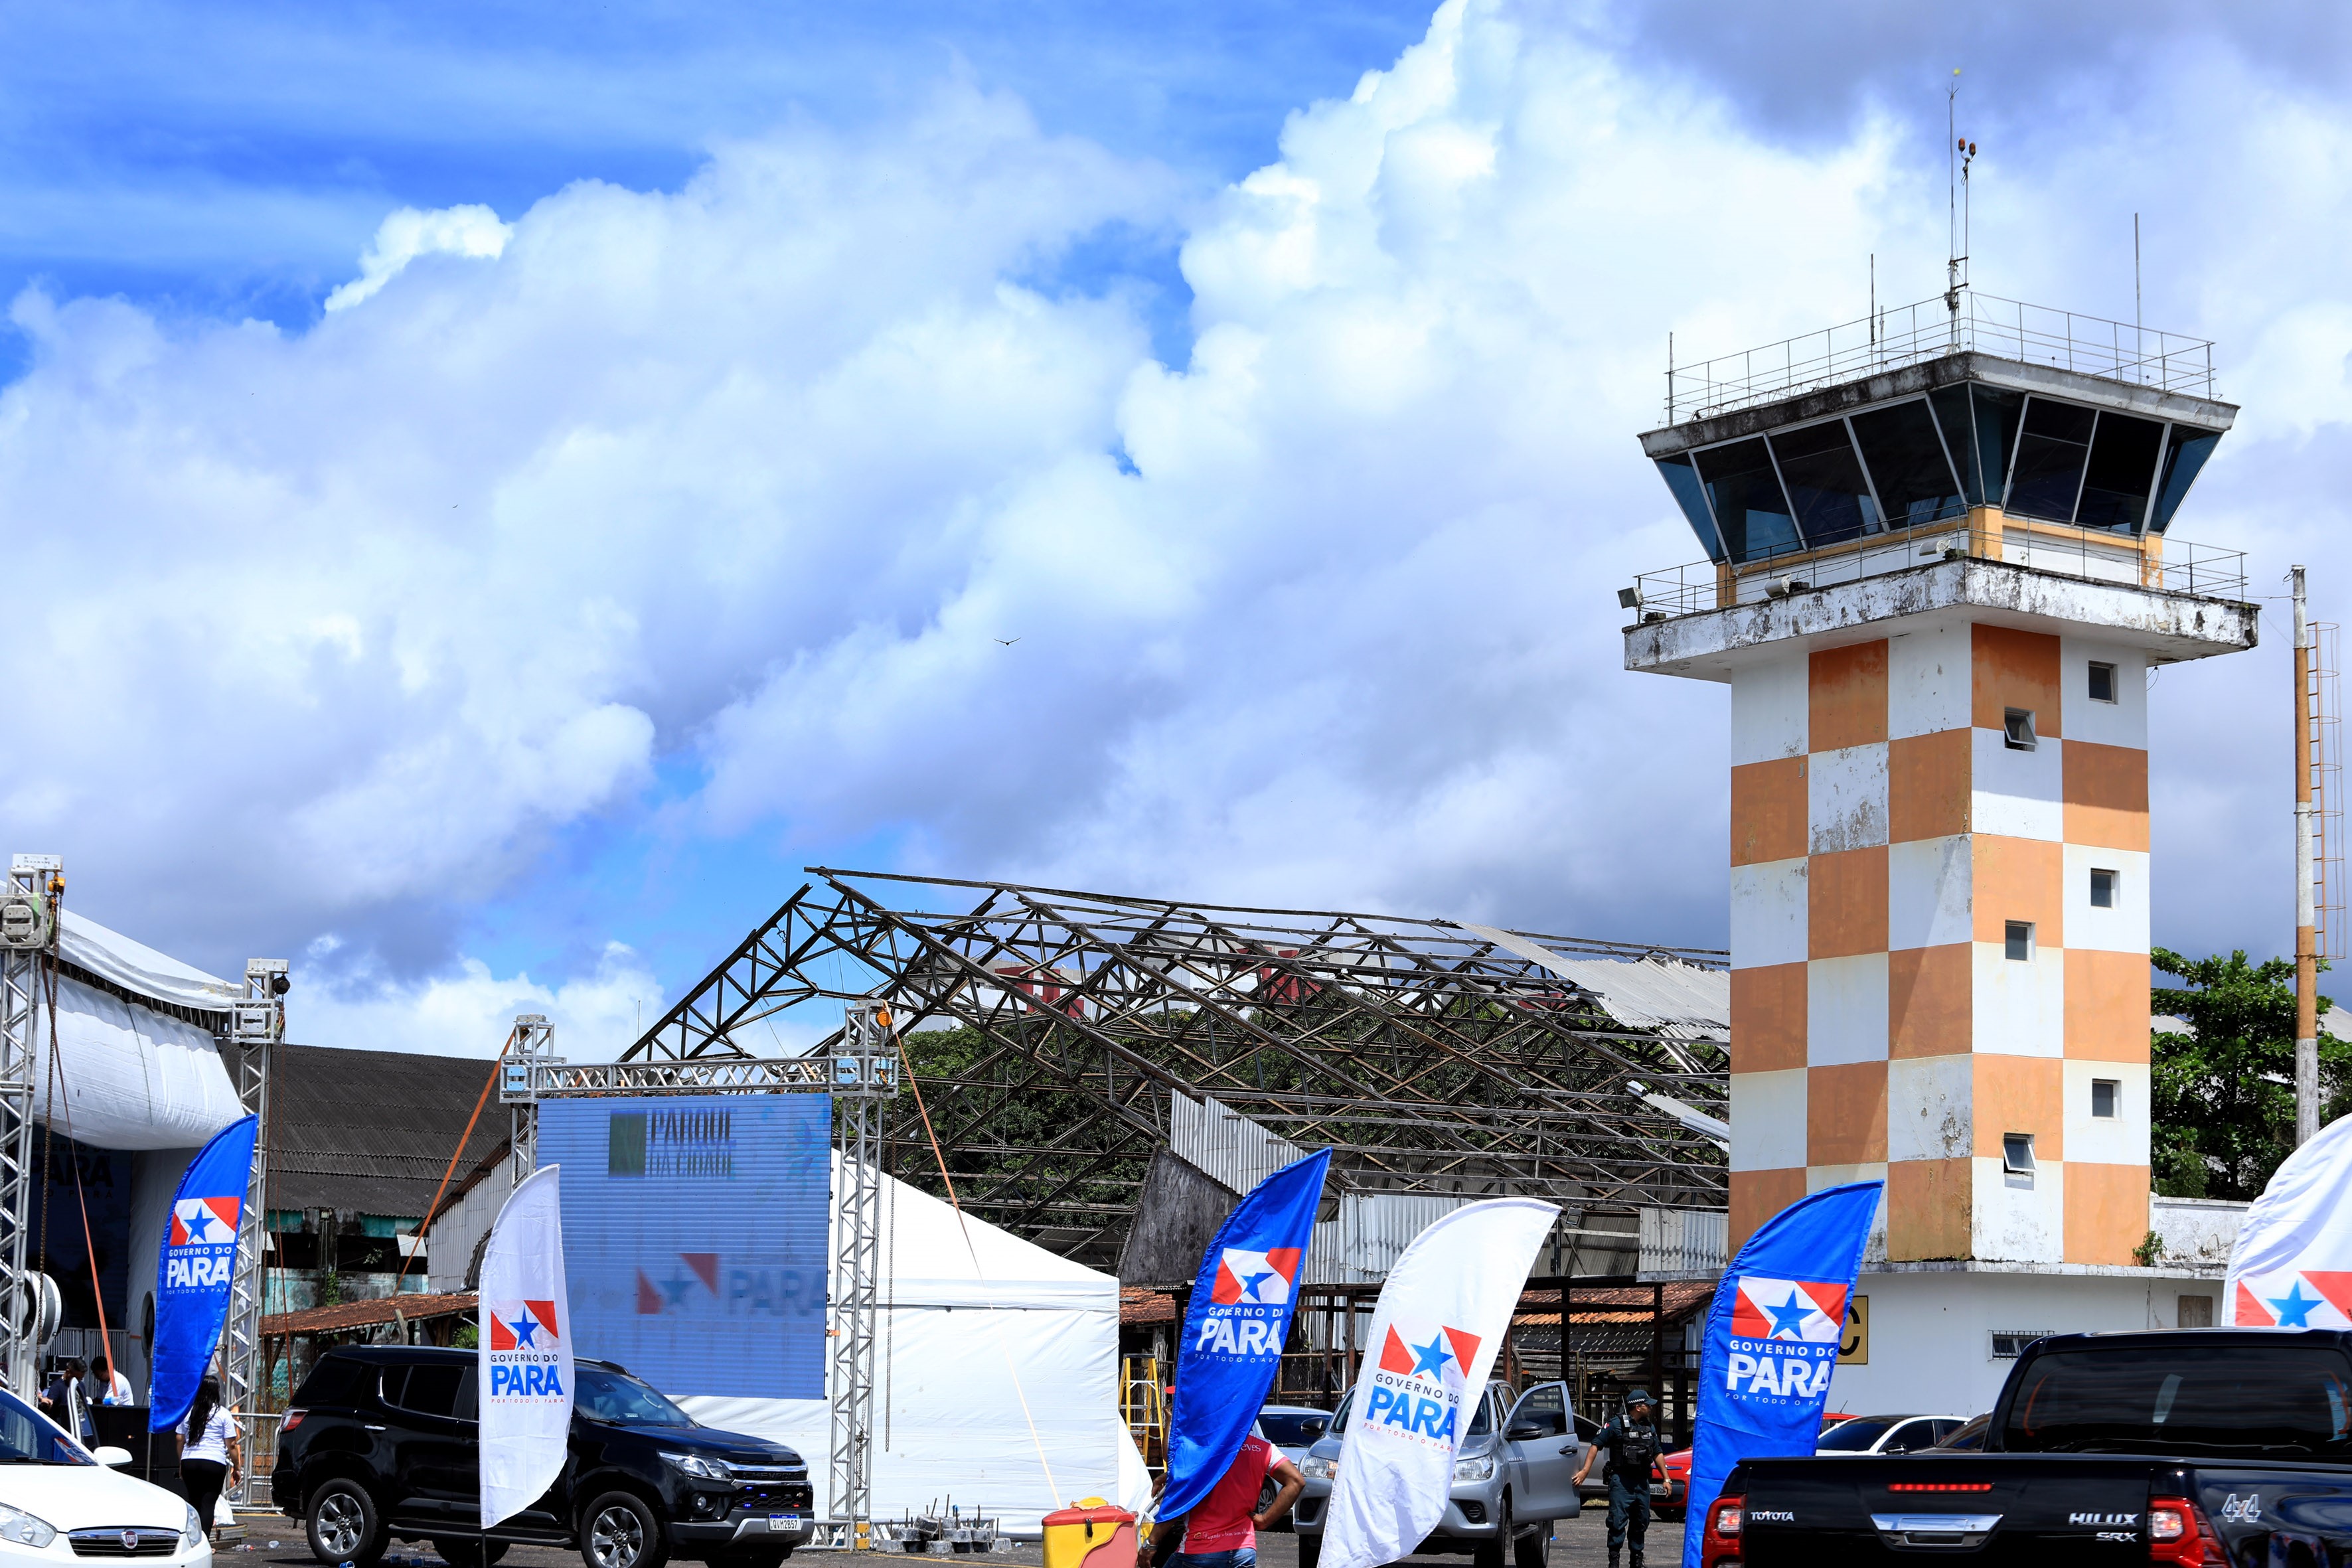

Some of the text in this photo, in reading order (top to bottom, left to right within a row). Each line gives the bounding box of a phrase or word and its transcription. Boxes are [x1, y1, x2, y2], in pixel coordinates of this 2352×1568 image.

[169, 1247, 210, 1257] GOVERNO
[1729, 1340, 1808, 1356] GOVERNO
[544, 1354, 558, 1362] DO
[1375, 1373, 1459, 1404] GOVERNO DO
[1755, 1397, 1786, 1405] TODO
[1364, 1422, 1381, 1432] POR
[1387, 1429, 1413, 1441] TODO
[1751, 1511, 1794, 1521] TOYOTA
[2068, 1512, 2140, 1526] HILUX
[773, 1520, 798, 1529] QVM2B57
[2095, 1532, 2139, 1542] SRX
